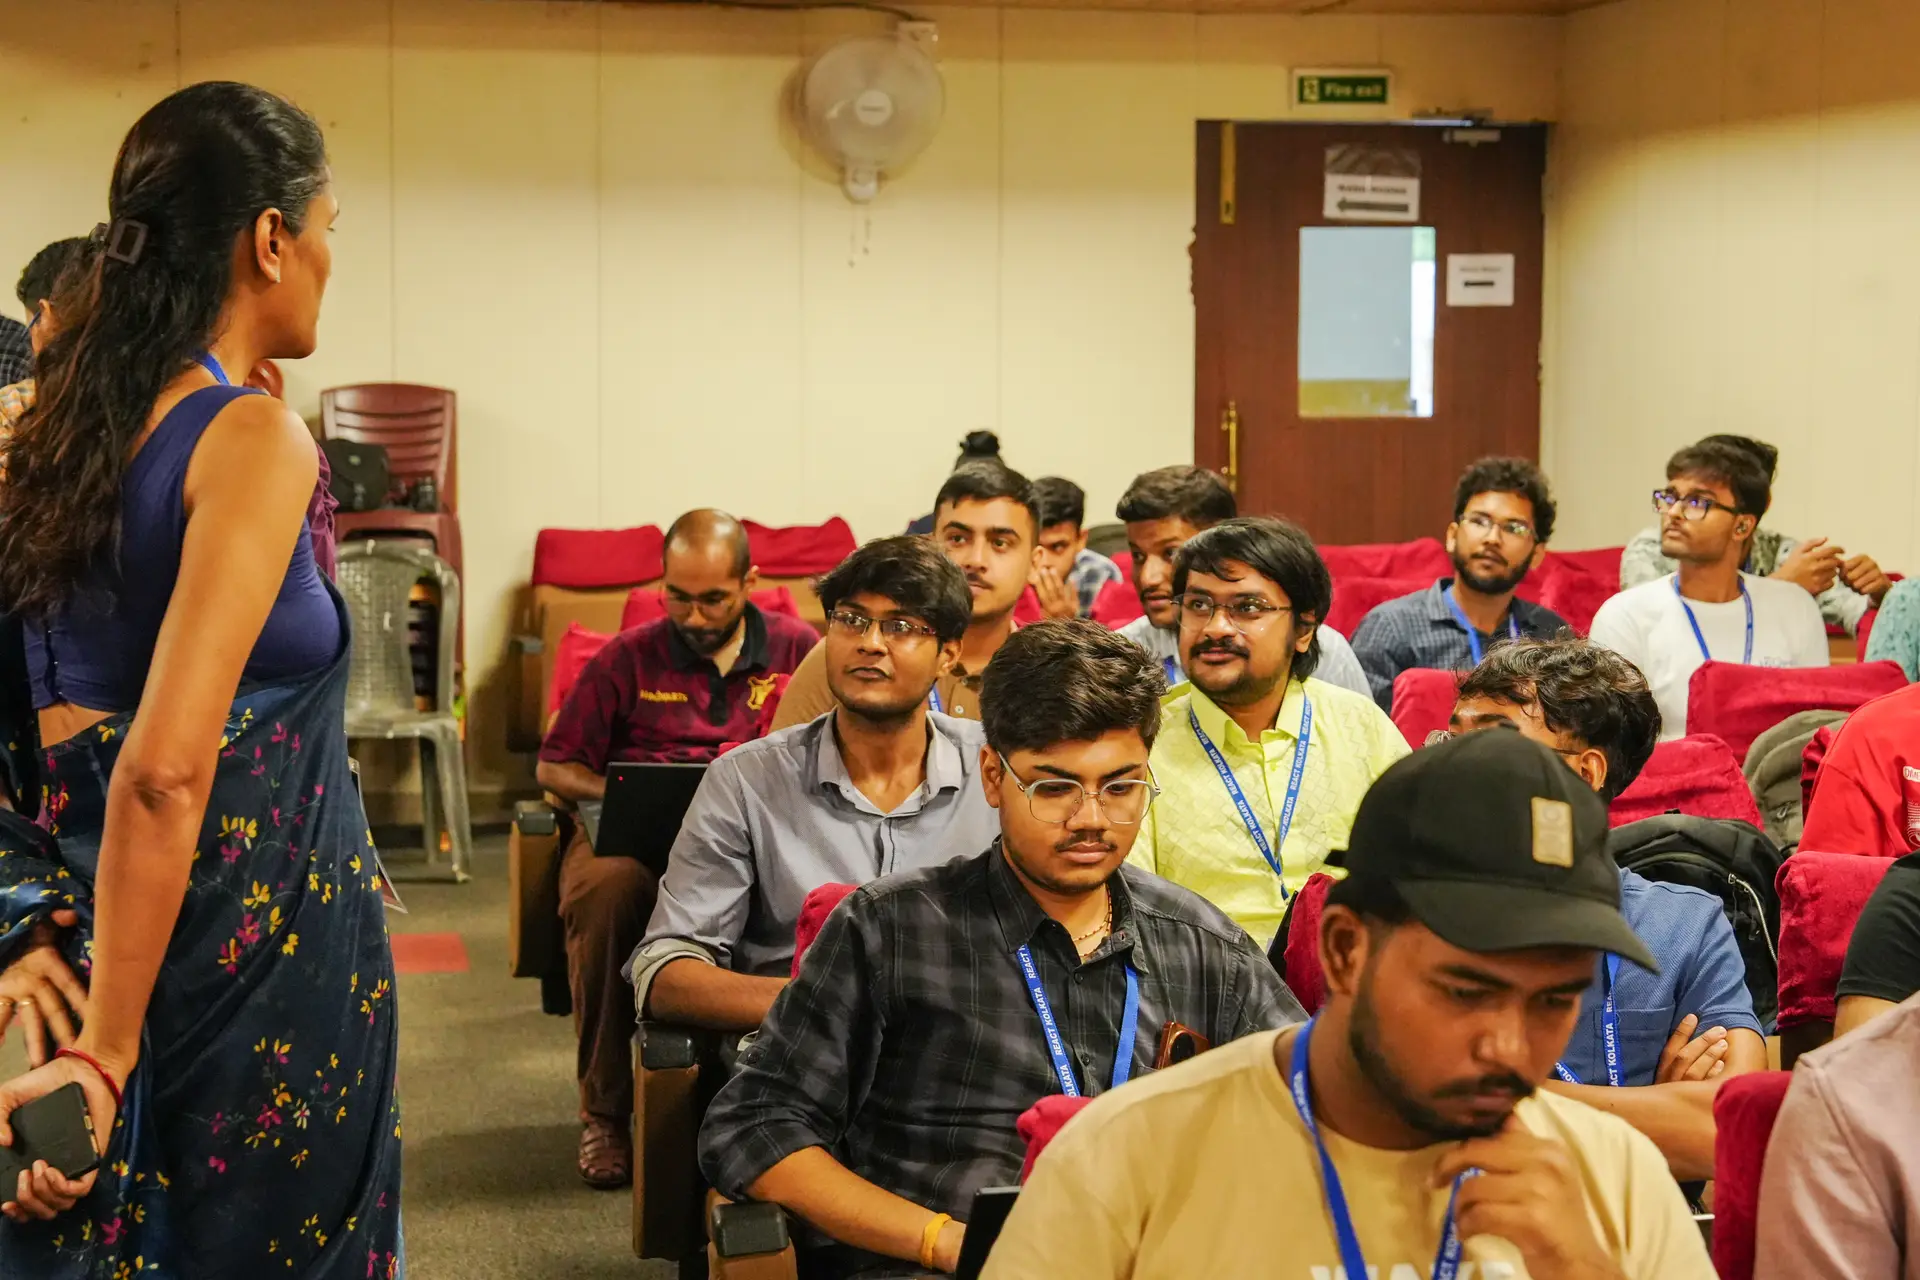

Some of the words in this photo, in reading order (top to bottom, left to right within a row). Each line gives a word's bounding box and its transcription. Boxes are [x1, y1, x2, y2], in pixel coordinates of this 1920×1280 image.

[1208, 748, 1228, 777] KOLKATA
[1290, 769, 1301, 790] REACT
[1296, 740, 1307, 769] KOLKATA
[1222, 773, 1239, 795] REACT
[1237, 799, 1257, 830] KOLKATA
[1253, 829, 1268, 851] REACT
[1020, 952, 1037, 978] REACT
[1034, 987, 1053, 1026] KOLKATA
[1048, 1028, 1063, 1055] REACT
[1606, 1022, 1617, 1066] KOLKATA
[1060, 1064, 1077, 1097] OLKATA
[1609, 1068, 1619, 1087] ACT
